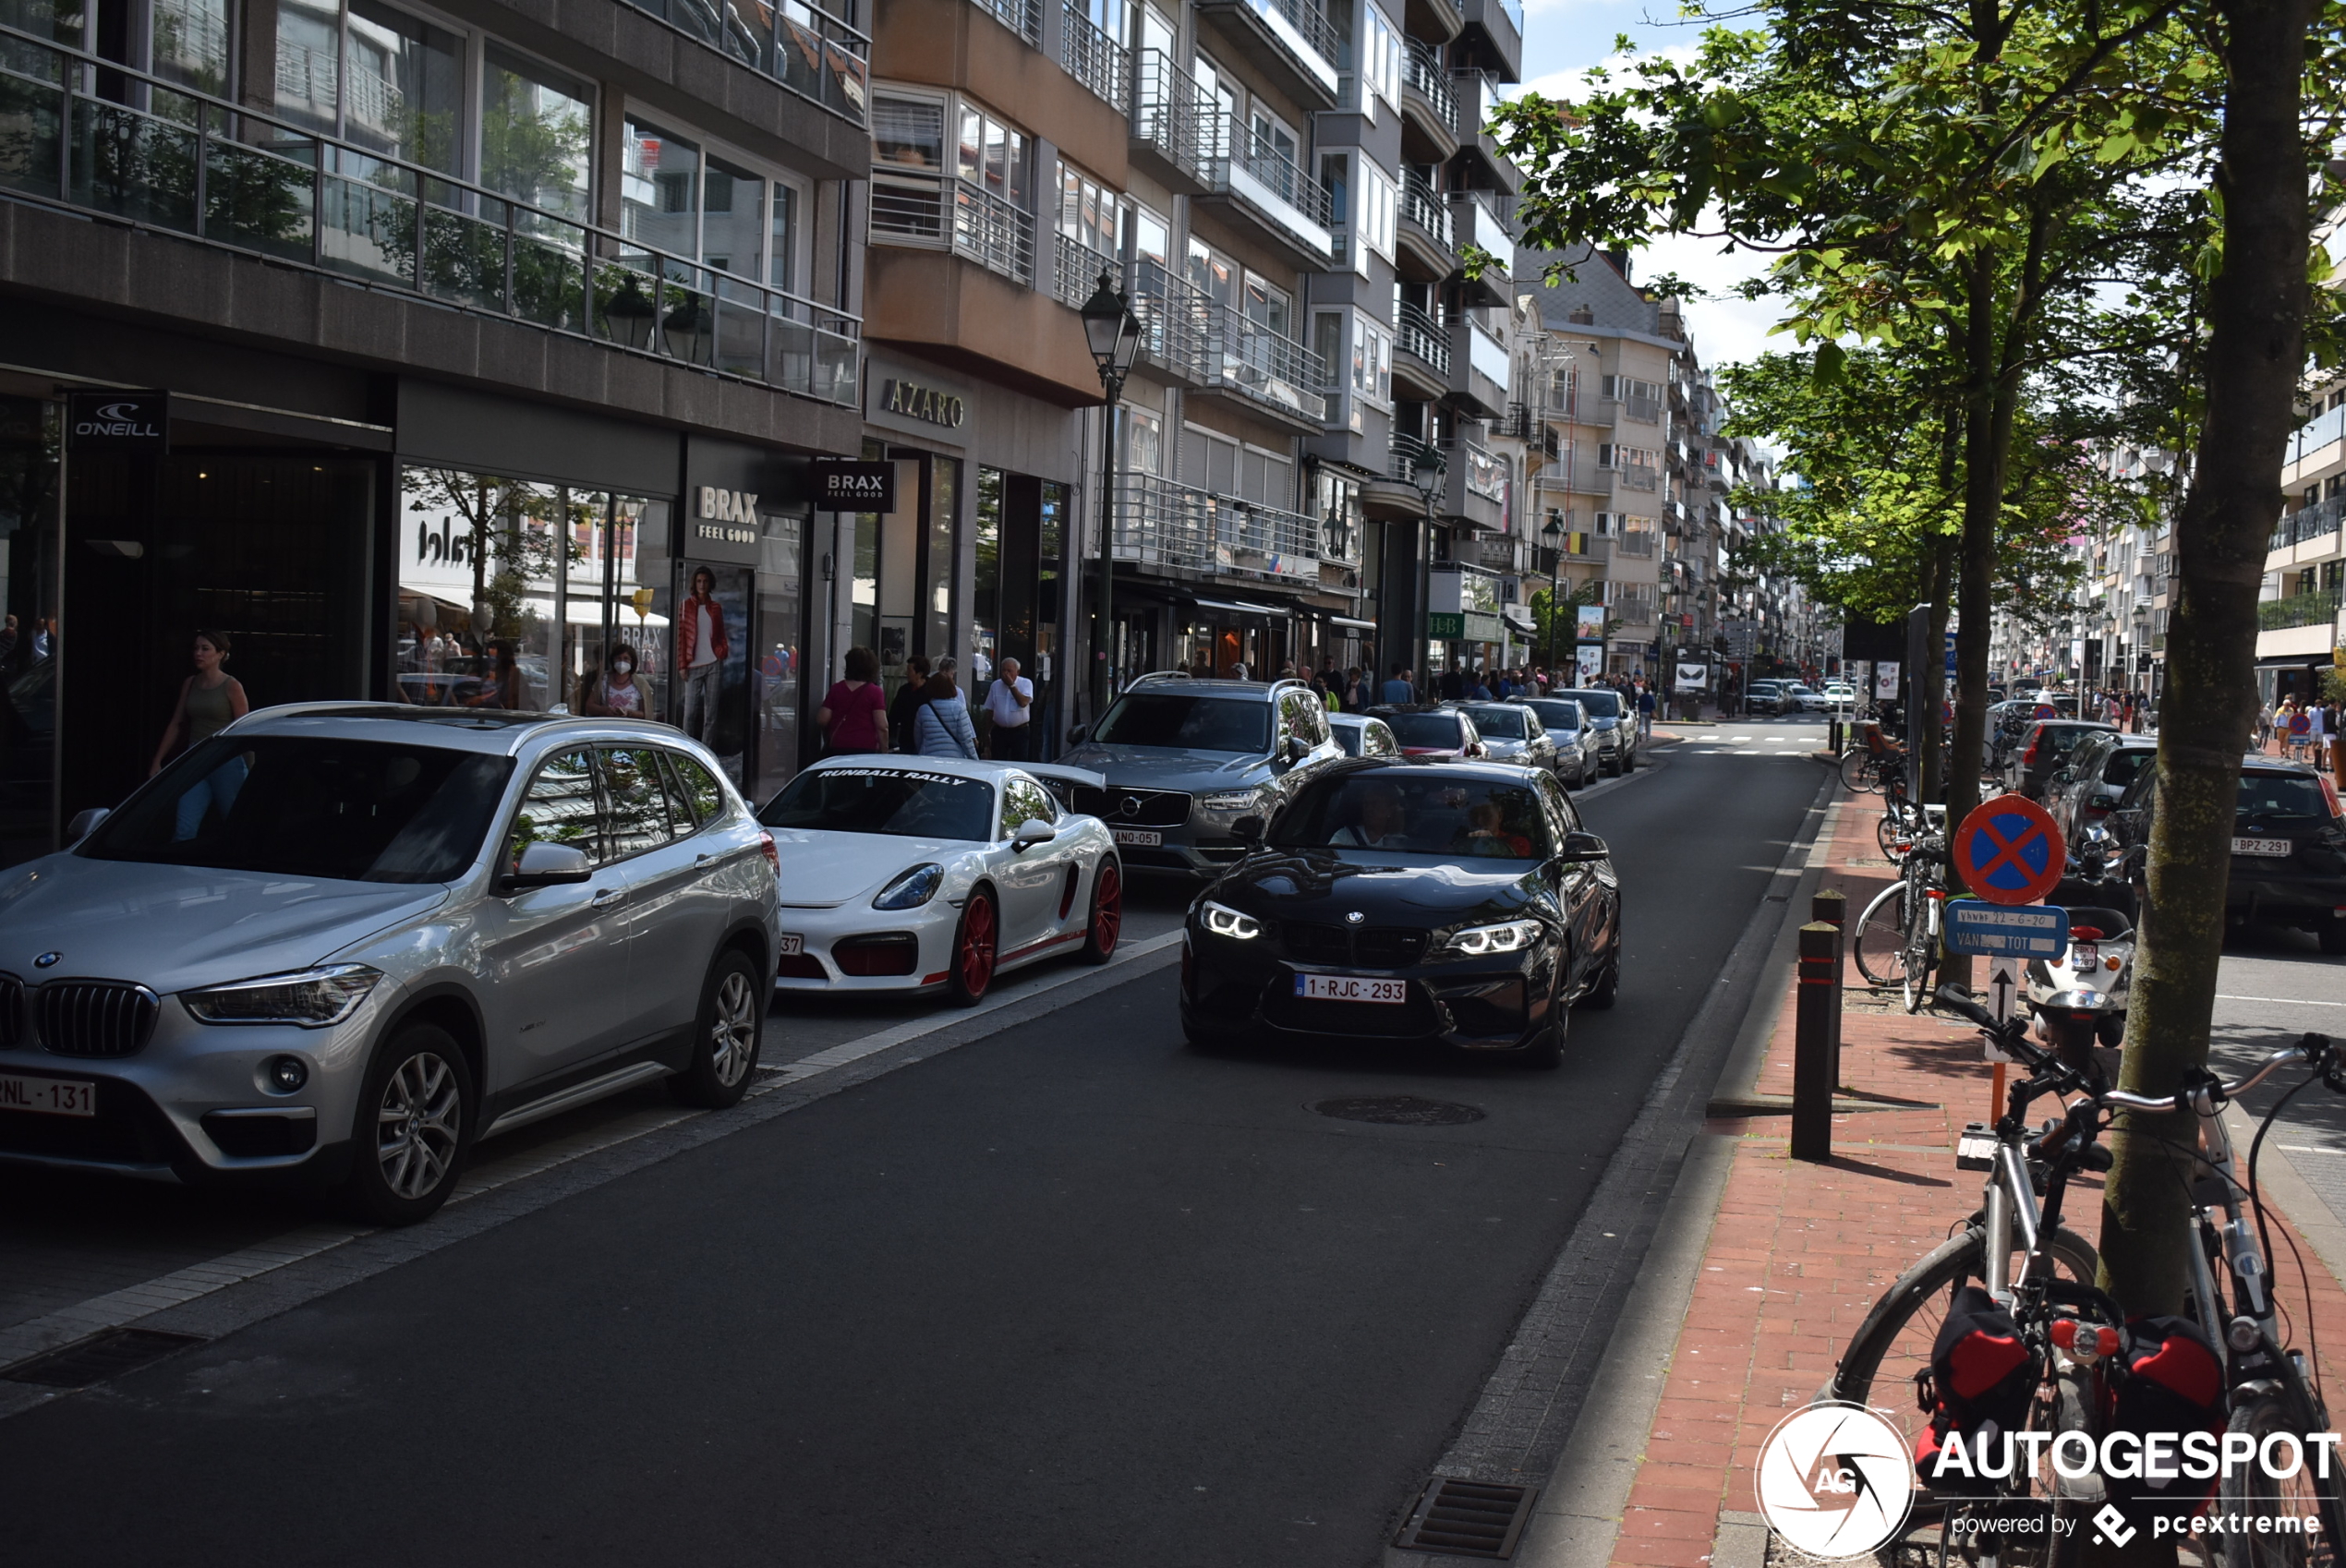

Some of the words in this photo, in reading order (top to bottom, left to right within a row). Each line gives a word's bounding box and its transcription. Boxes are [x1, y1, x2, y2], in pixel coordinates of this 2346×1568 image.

[889, 378, 963, 428] AZARO
[76, 422, 159, 436] O'NEILL
[828, 475, 883, 489] BRAX
[700, 486, 758, 525] BRAX
[698, 525, 725, 540] FEEL
[727, 528, 756, 544] GOOD
[622, 626, 661, 649] BRAX
[818, 769, 900, 778] RUNBALL
[903, 772, 968, 786] RALLY
[1957, 932, 1979, 947] VAN
[2007, 935, 2028, 950] TOT
